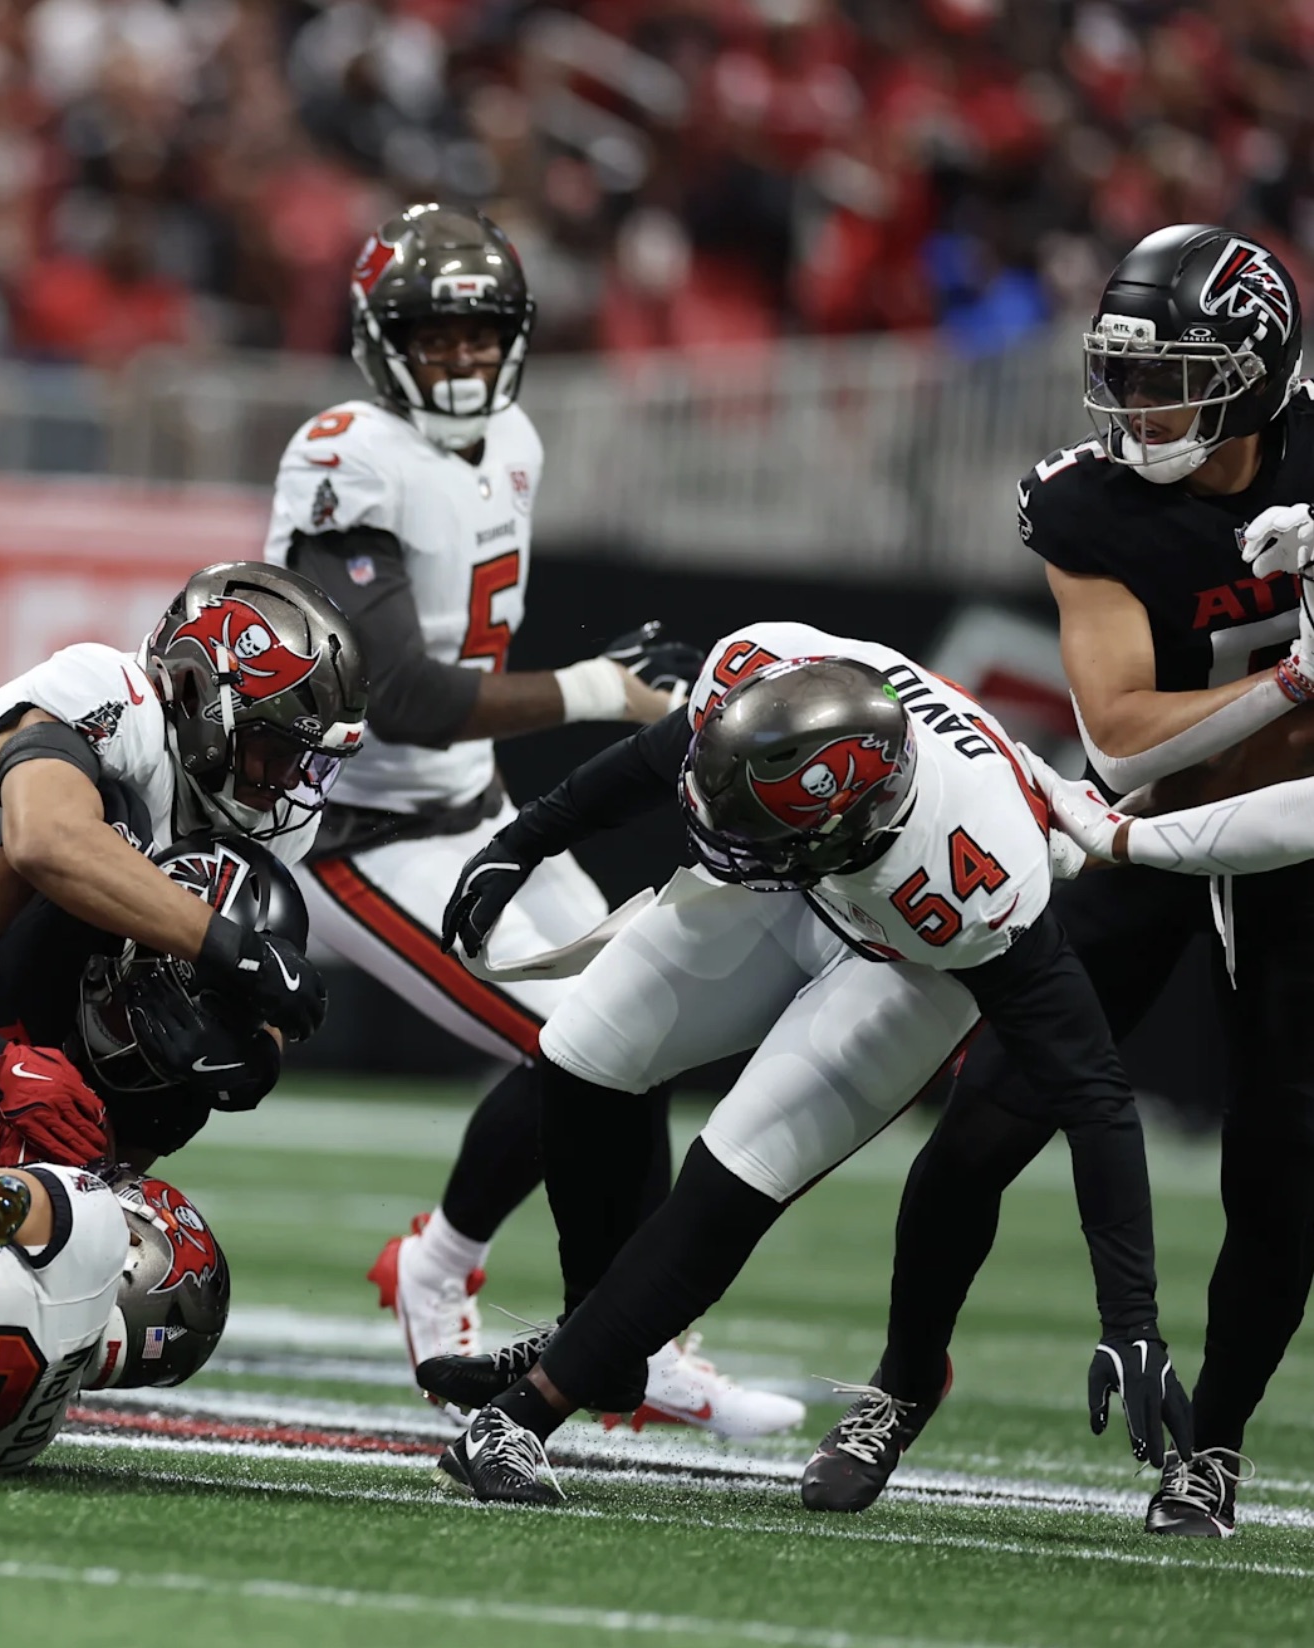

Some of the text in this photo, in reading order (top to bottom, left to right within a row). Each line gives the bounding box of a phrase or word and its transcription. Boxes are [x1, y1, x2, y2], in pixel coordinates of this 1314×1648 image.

[458, 548, 520, 675] 5
[1192, 569, 1302, 630] AT
[882, 664, 997, 760] DAVID
[889, 824, 1011, 947] 54
